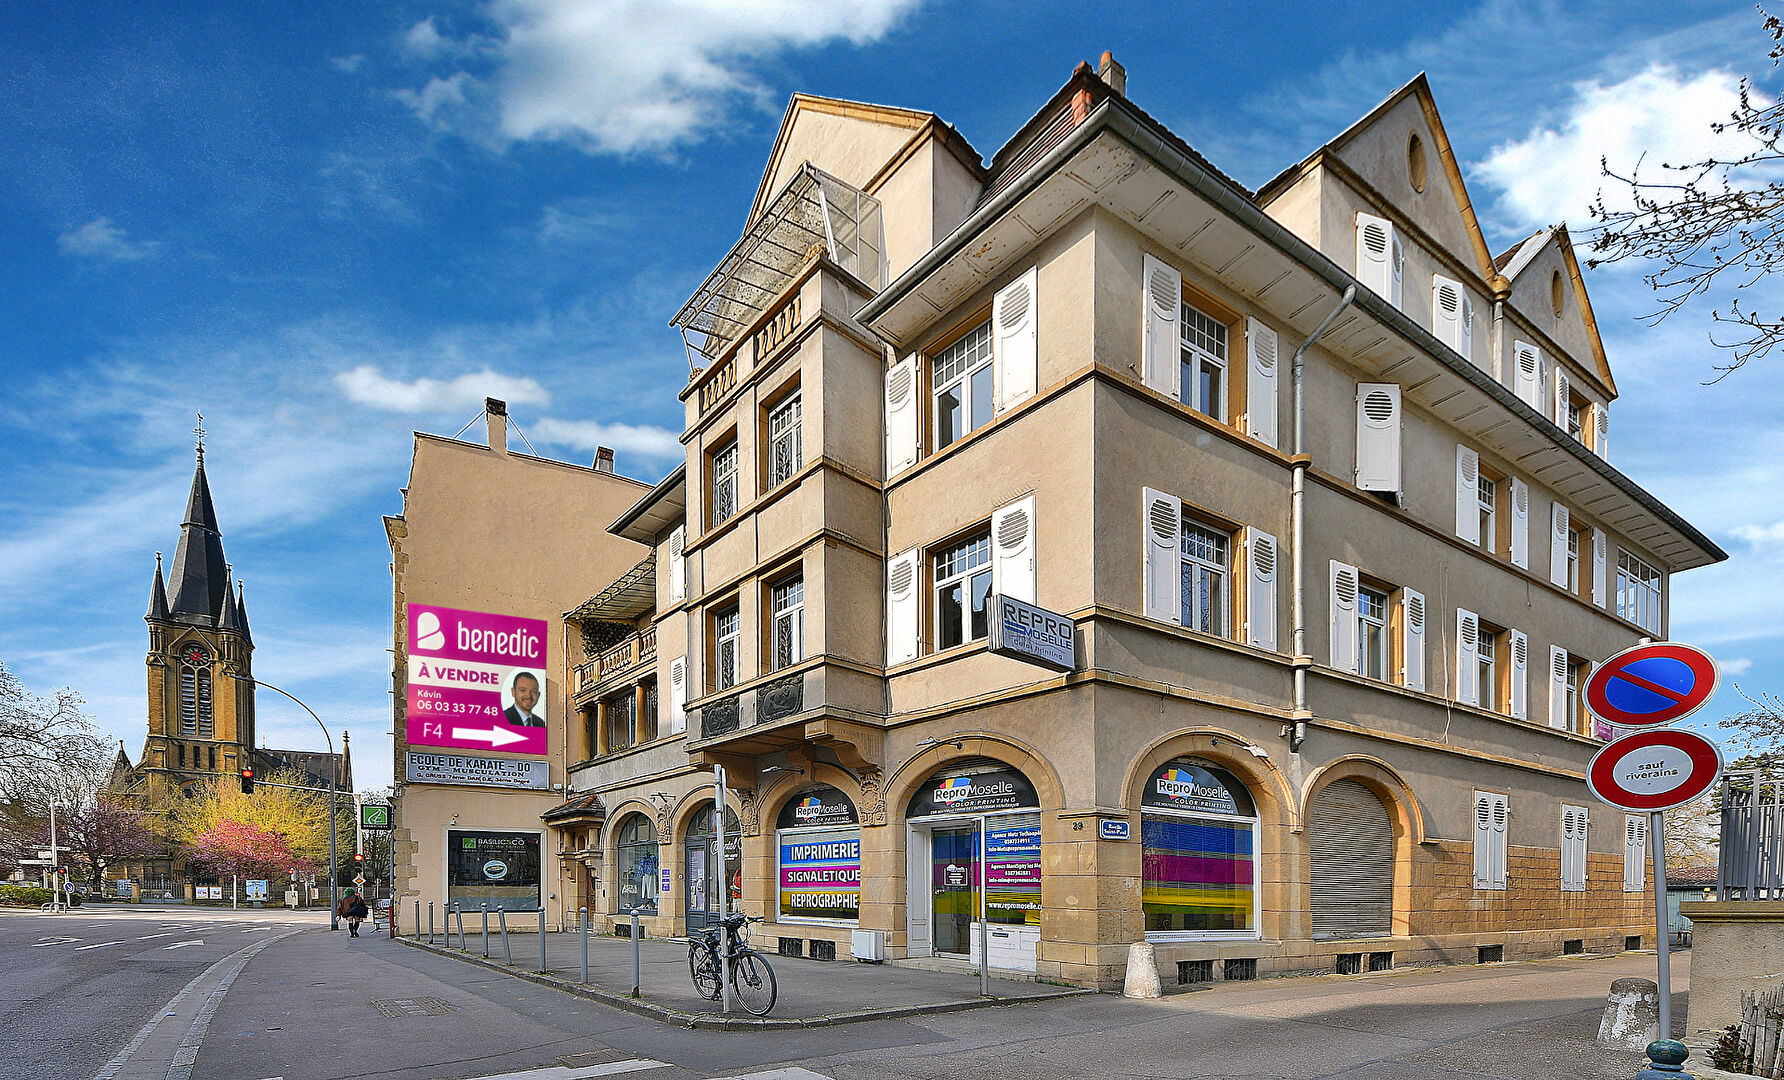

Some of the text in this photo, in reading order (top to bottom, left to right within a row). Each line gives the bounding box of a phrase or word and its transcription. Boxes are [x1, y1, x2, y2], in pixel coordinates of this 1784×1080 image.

[1003, 602, 1072, 640] REPRO
[457, 620, 539, 658] benedic
[1024, 628, 1072, 651] MOSELLE
[418, 662, 500, 685] À VENDRE
[417, 689, 442, 699] Kévin
[416, 699, 432, 711] 06
[434, 701, 450, 713] 03
[452, 703, 466, 714] 33
[467, 704, 482, 715] 77
[483, 705, 498, 717] 48
[423, 722, 443, 739] F4
[410, 754, 445, 767] ECOLE
[448, 757, 463, 768] DE
[465, 759, 505, 771] KARATE
[517, 762, 531, 773] DO
[1638, 760, 1665, 771] sauf
[453, 767, 525, 778] MUSCULATION
[1625, 768, 1679, 781] riverains
[935, 781, 1013, 800] ReproMoselle
[1159, 780, 1230, 799] ReproMoselle
[797, 803, 849, 817] ReproMoselle
[950, 796, 1017, 809] COLOR PRINTING
[1174, 798, 1232, 810] COLOR PRINTING
[791, 842, 859, 861] IMPRIMERIE
[787, 869, 861, 883] SIGNALETIQUE
[791, 893, 859, 909] REPROGRAPHIE
